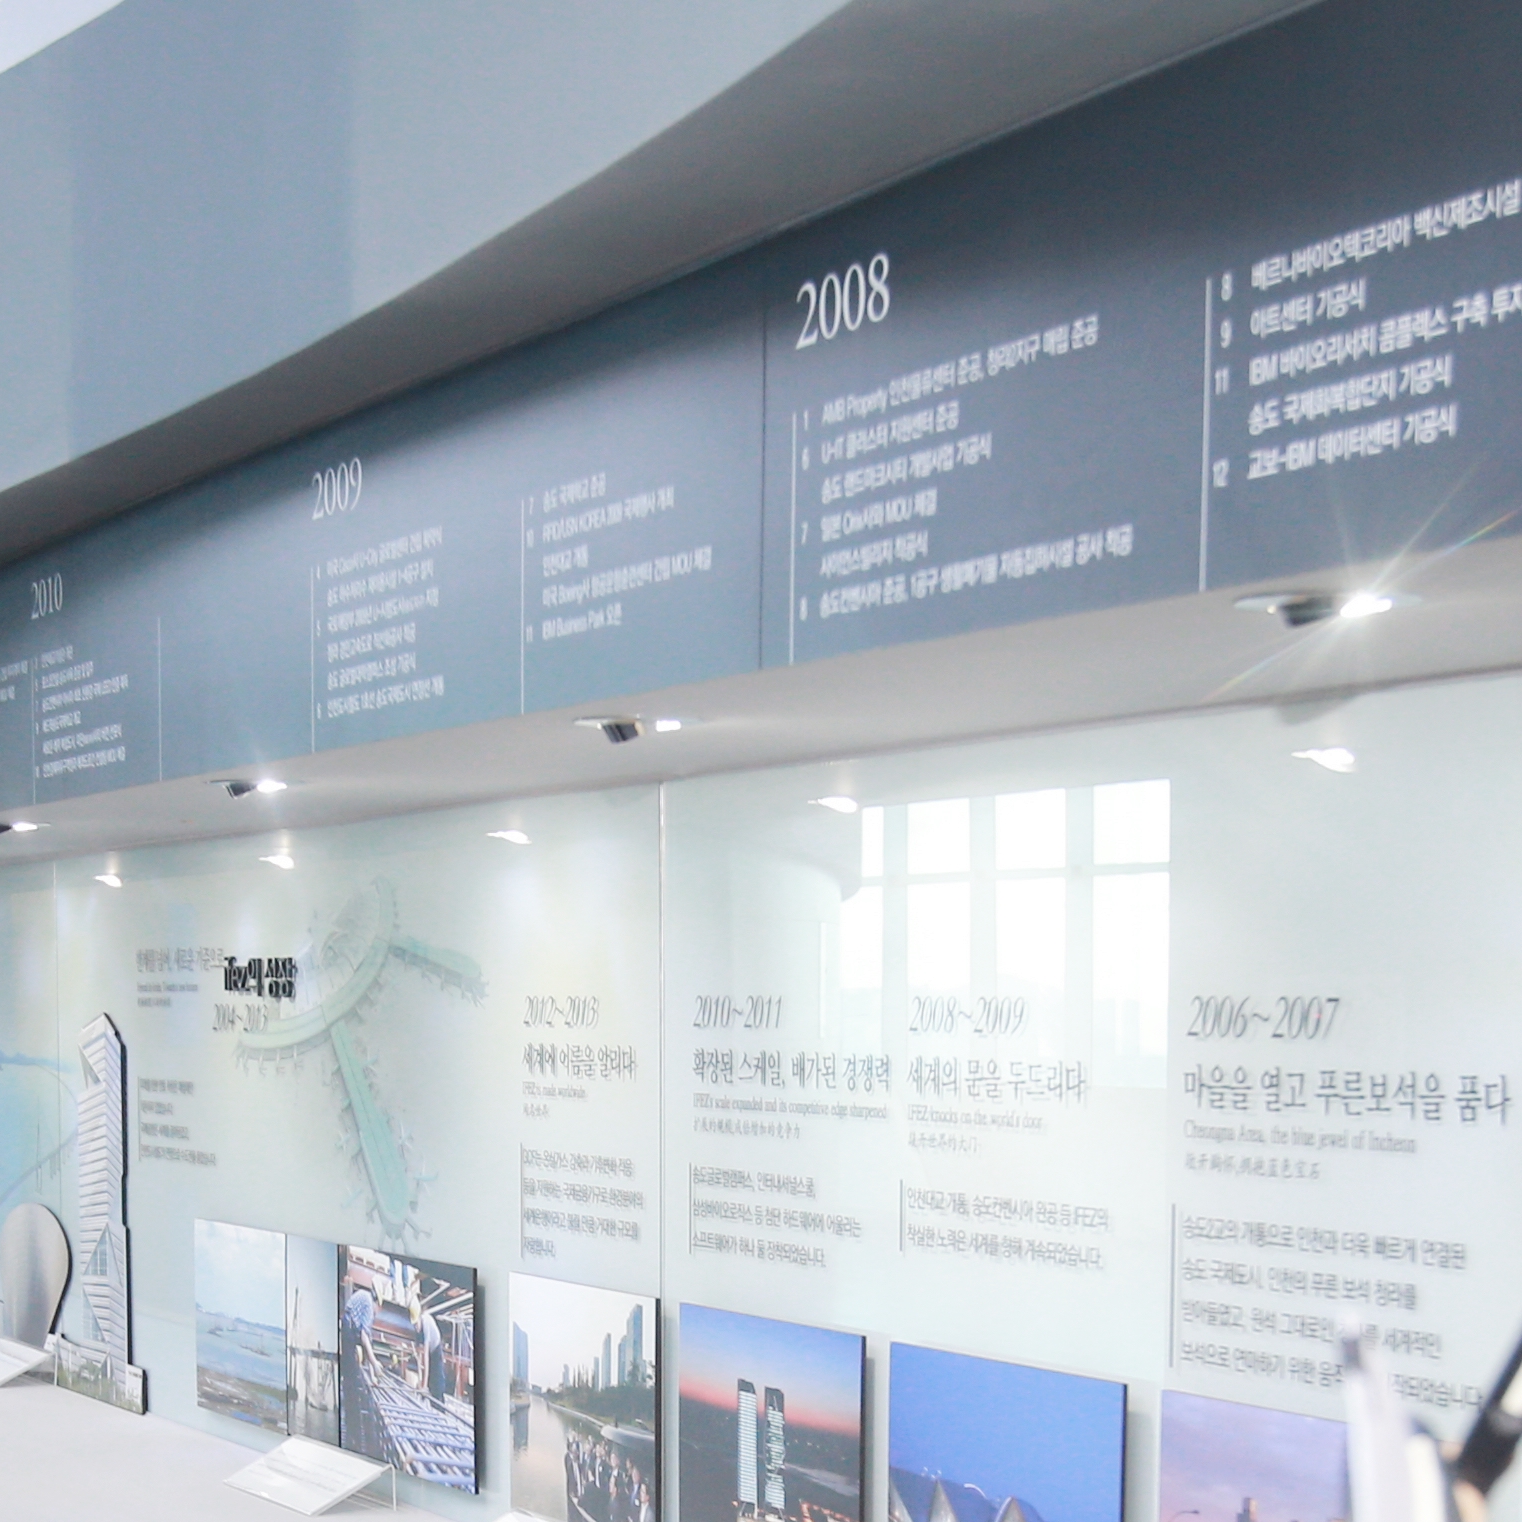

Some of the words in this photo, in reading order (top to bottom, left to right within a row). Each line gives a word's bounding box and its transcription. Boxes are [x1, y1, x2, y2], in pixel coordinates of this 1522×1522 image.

[1221, 270, 1233, 301] 8
[1413, 178, 1522, 240] 백신제조시설
[795, 252, 891, 350] 2008
[1219, 318, 1233, 349] 9
[1250, 294, 1314, 339] 아트센터
[1316, 277, 1367, 320] 기공식
[1215, 367, 1229, 395] 11
[1279, 324, 1377, 378] 바이오리서치
[1378, 306, 1451, 354] 콤플렉스
[1450, 291, 1491, 332] 구축
[1248, 398, 1282, 436] 송도
[1398, 350, 1453, 396] 기공식
[1317, 416, 1401, 465] 데이터센터
[1402, 401, 1458, 446] 기공식
[312, 456, 363, 520] 2009
[31, 572, 63, 620] 2010
[523, 995, 600, 1028] 2012~2013
[693, 995, 783, 1029] 2010~2011
[909, 996, 1027, 1037] 2008~2009
[1186, 995, 1341, 1040] 2006~2007
[521, 1042, 557, 1077] 세계에
[559, 1043, 597, 1079] 이름을
[597, 1043, 638, 1081] 알리다
[693, 1047, 733, 1084] 확장된
[738, 1049, 786, 1089] 스케일,
[791, 1050, 837, 1089] 배가된
[842, 1053, 891, 1093] 경쟁력
[906, 1055, 959, 1098] 세계의
[965, 1058, 1001, 1100] 문을
[1007, 1060, 1087, 1104] 두드리다
[1261, 1065, 1306, 1113] 열고
[1314, 1070, 1447, 1122] 푸른보석을
[1454, 1074, 1512, 1126] 품다
